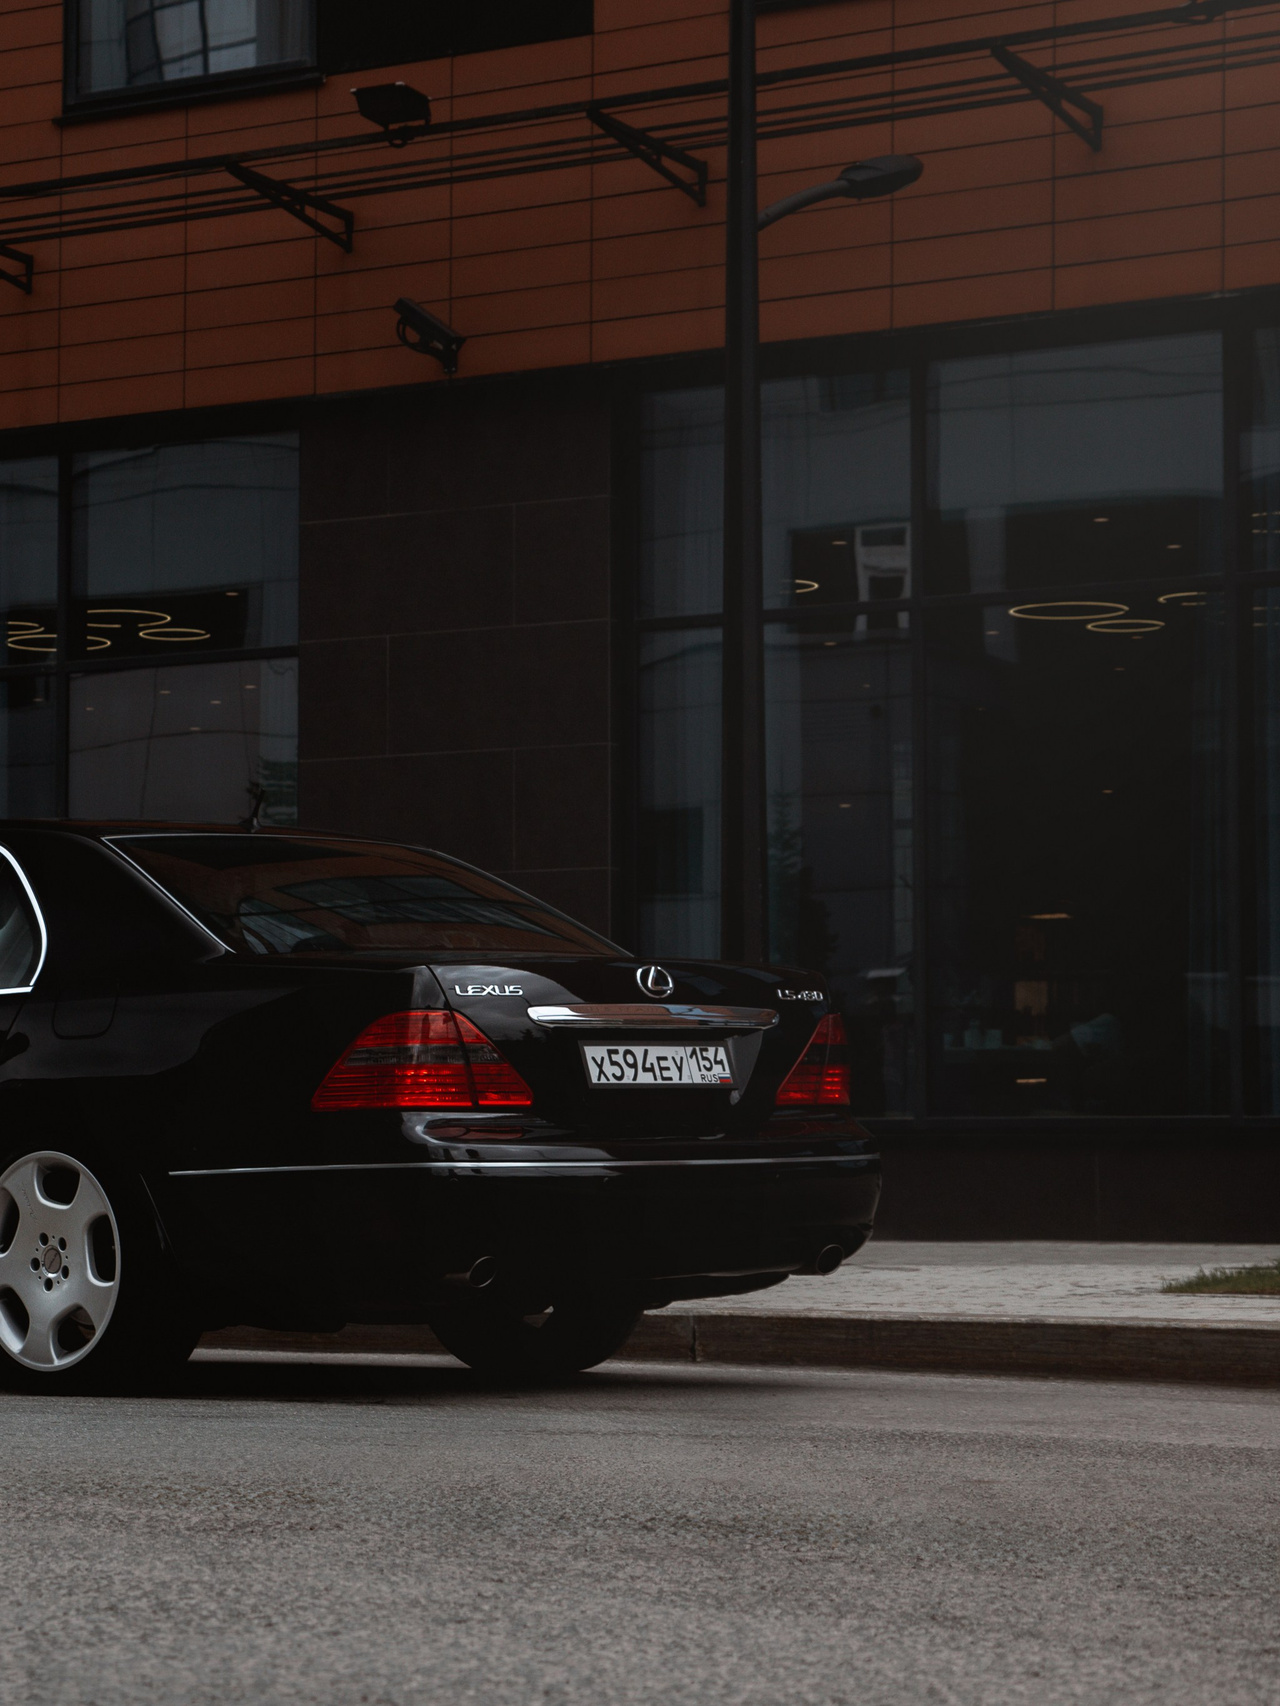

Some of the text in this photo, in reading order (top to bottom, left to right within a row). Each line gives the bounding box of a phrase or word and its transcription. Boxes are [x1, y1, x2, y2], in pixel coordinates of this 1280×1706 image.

[454, 984, 524, 996] LEXUS
[776, 988, 824, 1002] LS 430
[689, 1047, 726, 1072] 154
[700, 1073, 719, 1083] RUS
